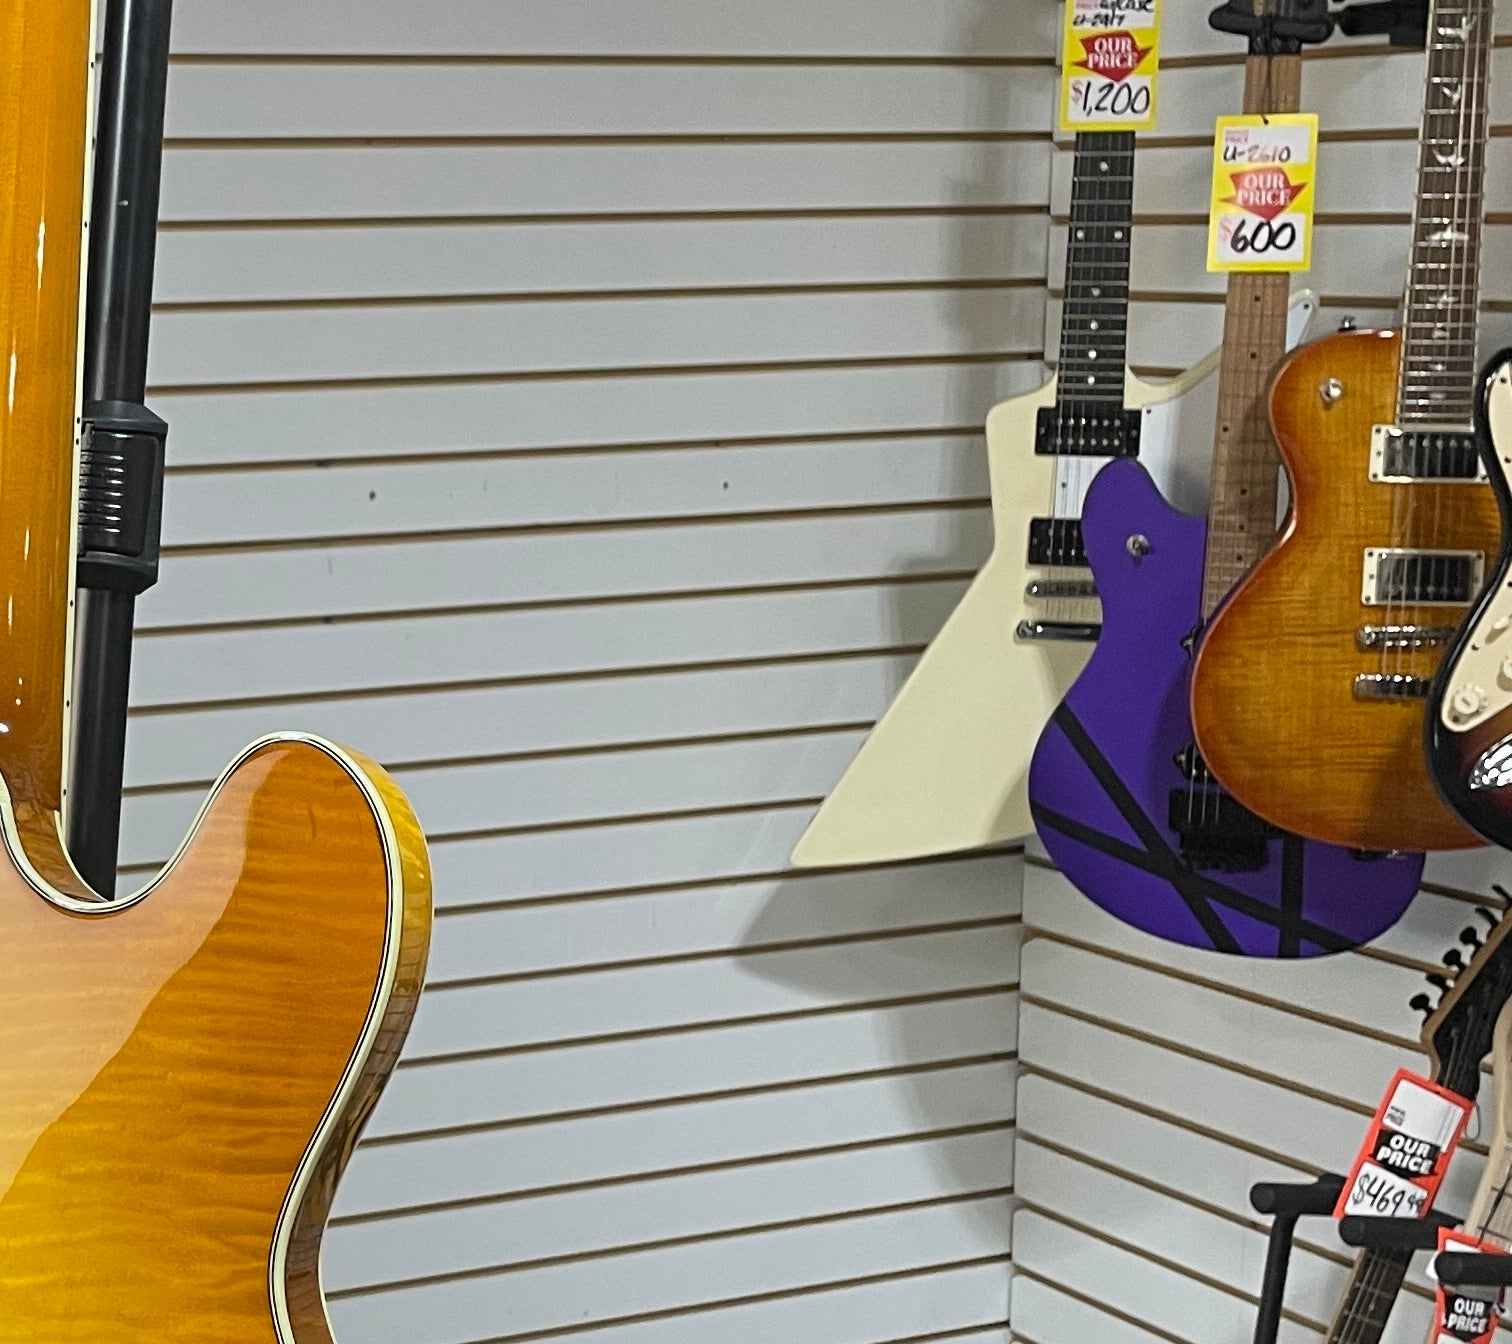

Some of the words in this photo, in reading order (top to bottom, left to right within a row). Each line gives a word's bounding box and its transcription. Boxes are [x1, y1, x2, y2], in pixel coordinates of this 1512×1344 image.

[1094, 36, 1132, 53] OUR
[1088, 51, 1139, 70] PRICE
[1071, 80, 1151, 118] $1,200
[1244, 172, 1286, 189] OUR
[1237, 188, 1292, 207] PRICE
[1389, 1134, 1432, 1158] OUR
[1376, 1145, 1435, 1175] PRICE
[1453, 1297, 1486, 1317] OUR
[1446, 1313, 1488, 1334] PRICE
